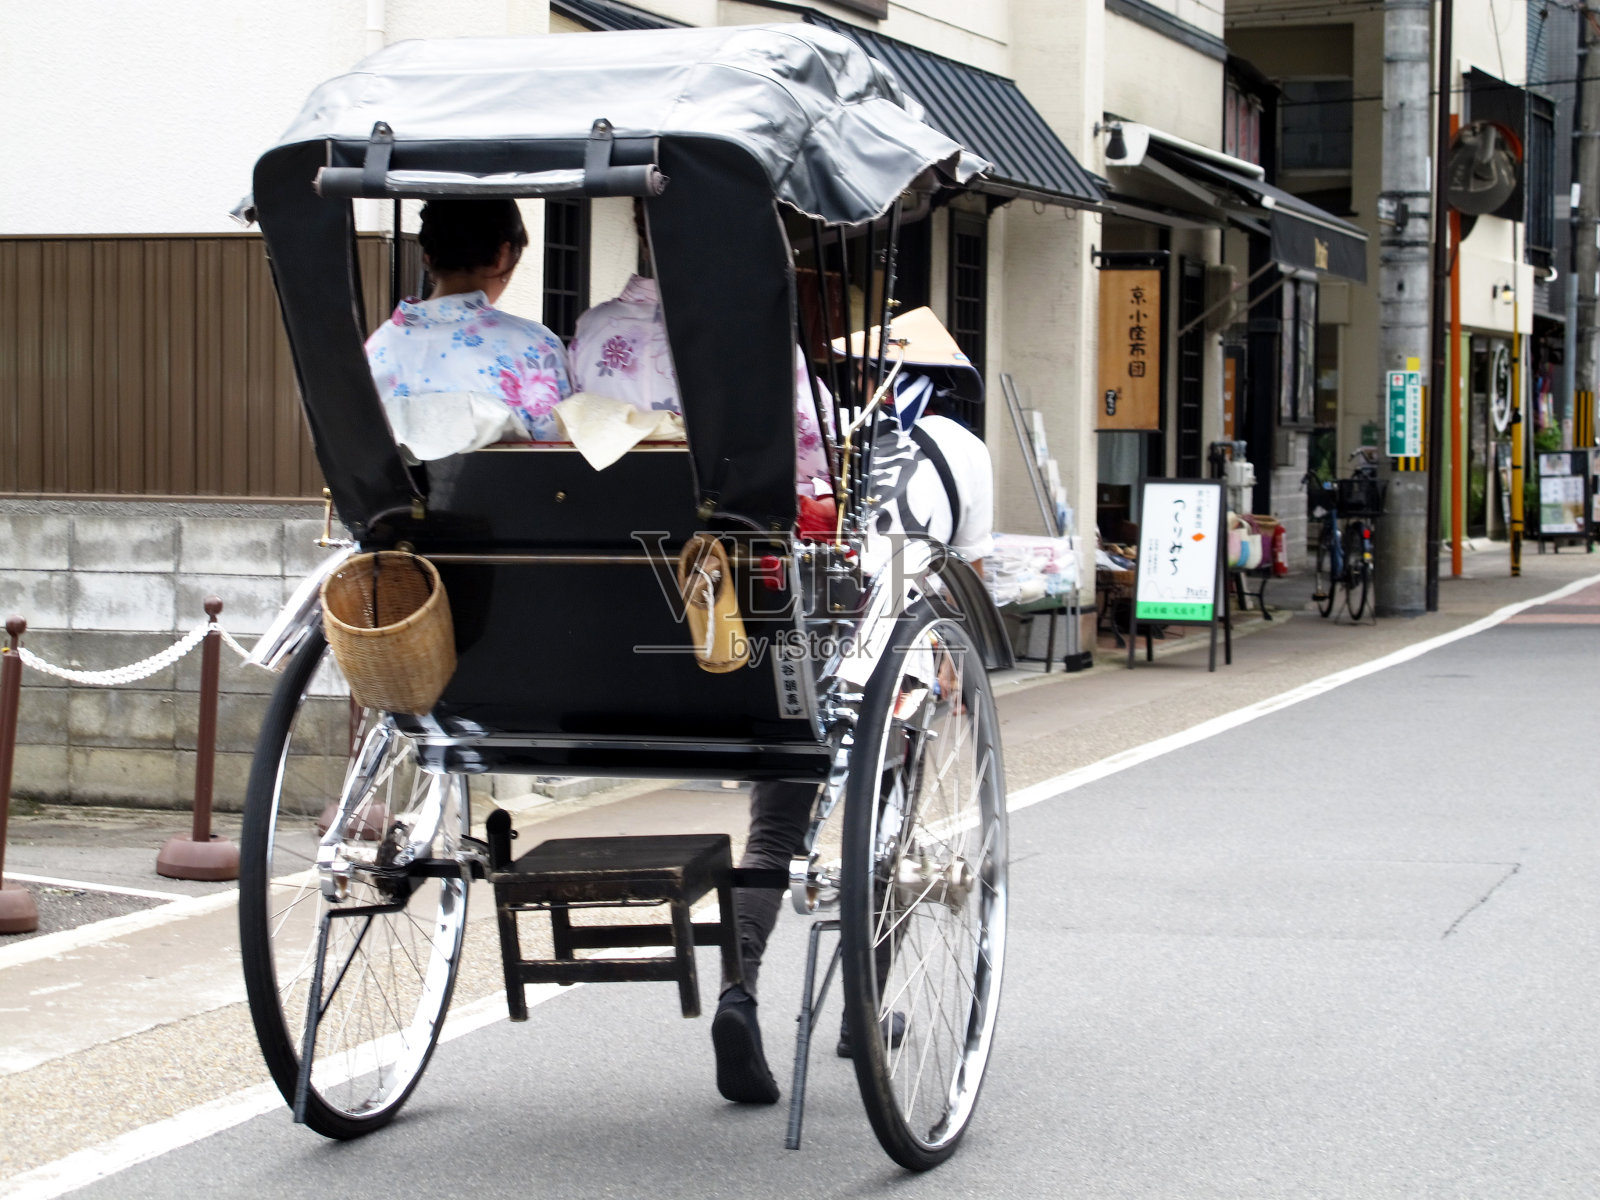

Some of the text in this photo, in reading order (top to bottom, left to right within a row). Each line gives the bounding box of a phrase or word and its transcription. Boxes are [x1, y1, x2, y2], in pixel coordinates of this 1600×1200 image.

[1128, 286, 1148, 378] 京小座布団
